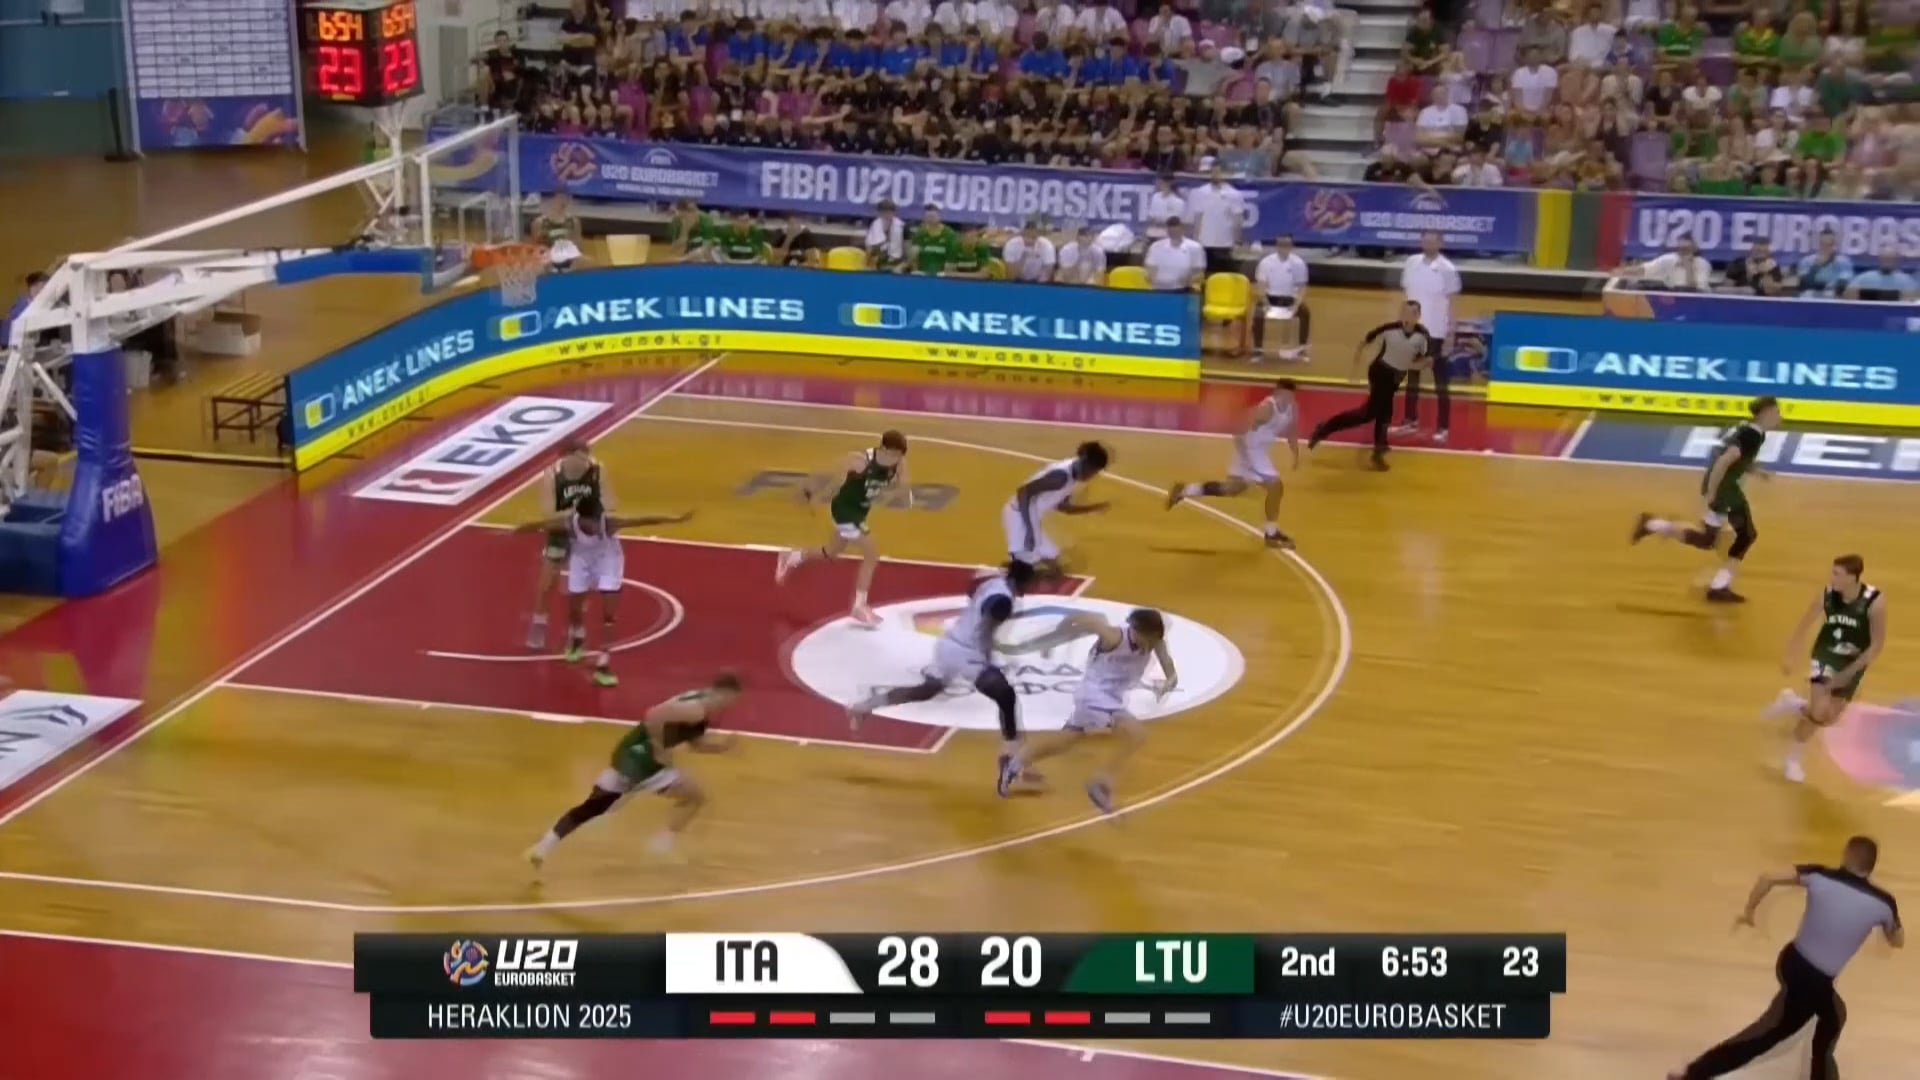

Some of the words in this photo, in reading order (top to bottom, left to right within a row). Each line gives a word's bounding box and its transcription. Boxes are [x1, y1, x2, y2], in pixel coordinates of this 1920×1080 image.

[319, 46, 361, 92] 23
[383, 39, 417, 91] 23
[761, 161, 839, 203] FIBA
[846, 166, 914, 204] U20
[924, 171, 1155, 223] EUROBASKET
[1638, 208, 1722, 249] U20
[557, 297, 662, 329] ANEK
[680, 296, 804, 321] LINES
[922, 309, 1038, 337] ANEK
[1054, 317, 1181, 346] LINES
[558, 333, 722, 356] www.anek.gr
[927, 346, 1096, 370] www.anek.gr
[343, 360, 401, 410] ANEK
[405, 329, 475, 376] LINES
[1593, 351, 1728, 382] ANEK
[1746, 360, 1898, 390] LINES
[437, 406, 575, 466] EKO
[102, 473, 143, 522] FIBA
